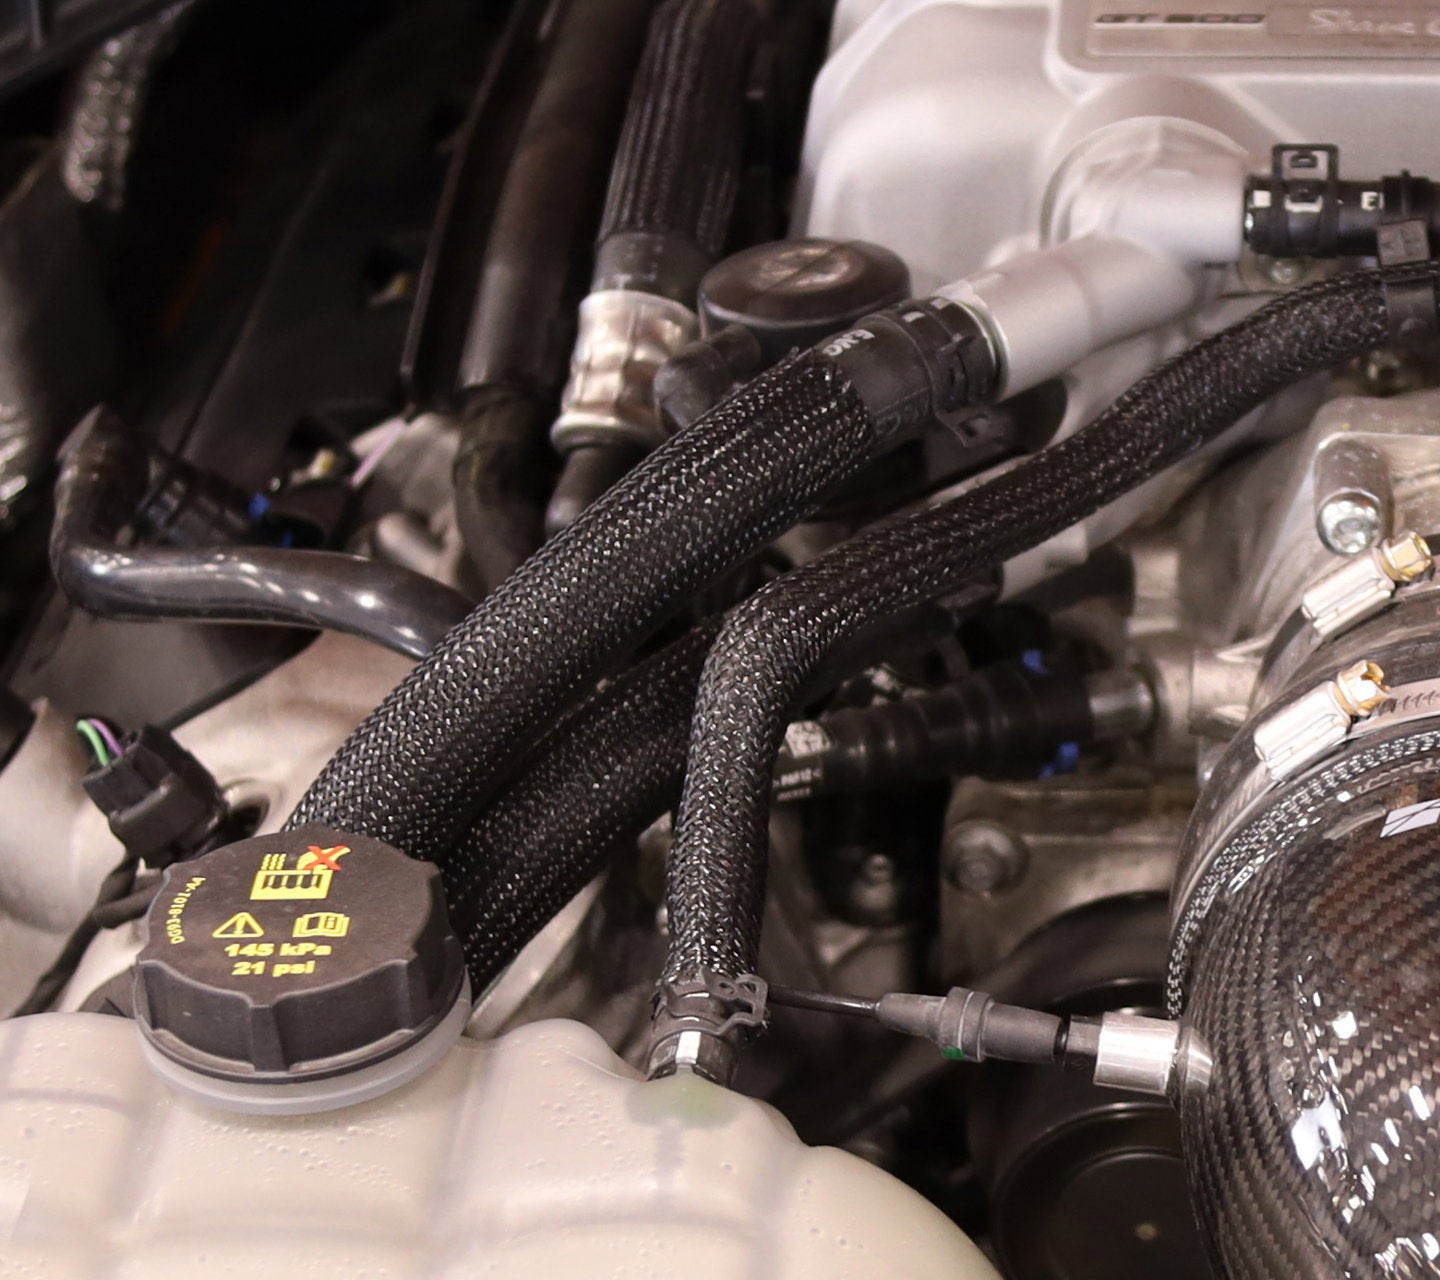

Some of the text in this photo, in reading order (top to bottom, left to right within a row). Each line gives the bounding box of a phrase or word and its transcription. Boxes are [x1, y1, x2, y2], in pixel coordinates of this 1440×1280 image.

[224, 942, 333, 957] 145 kPa
[232, 960, 316, 978] 21 psi
